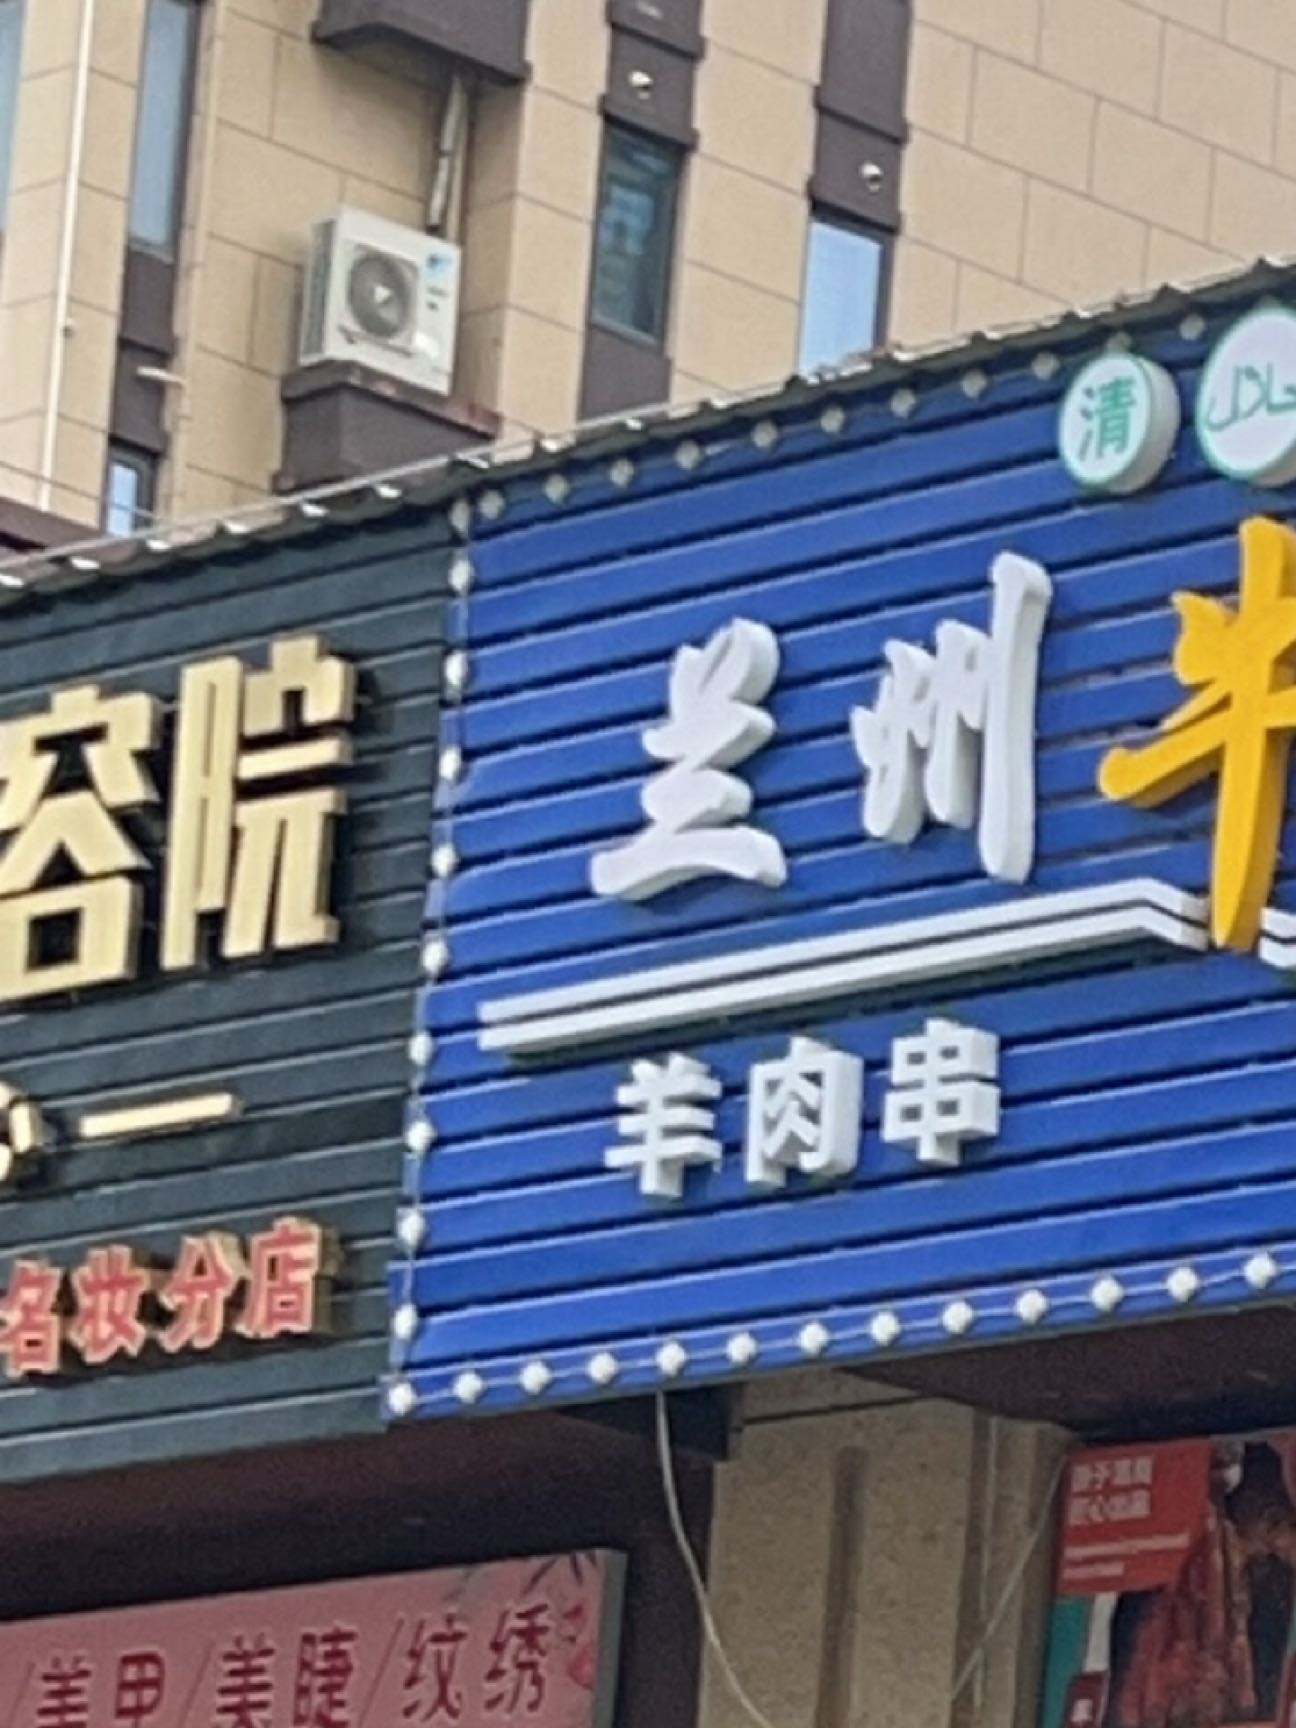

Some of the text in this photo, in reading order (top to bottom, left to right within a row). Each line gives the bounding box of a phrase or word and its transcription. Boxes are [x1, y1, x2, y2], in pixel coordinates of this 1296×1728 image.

[1078, 376, 1136, 461] 清
[605, 1018, 1000, 1198] 羊肉串
